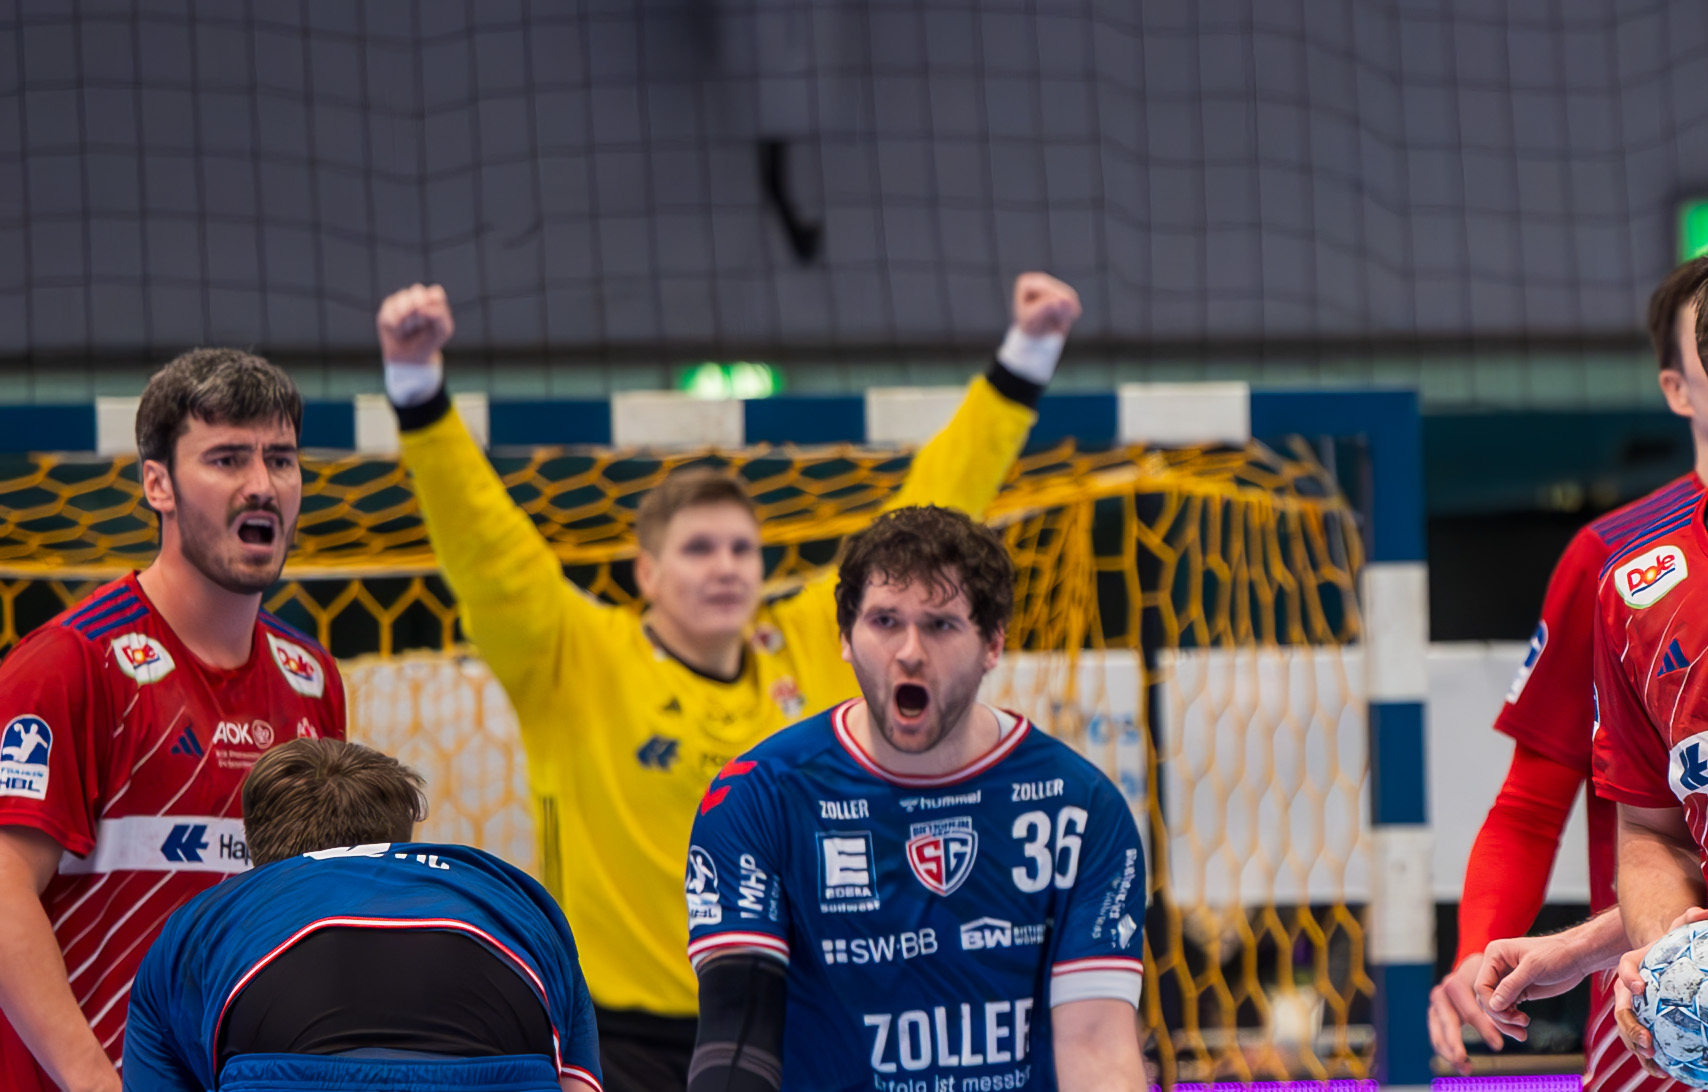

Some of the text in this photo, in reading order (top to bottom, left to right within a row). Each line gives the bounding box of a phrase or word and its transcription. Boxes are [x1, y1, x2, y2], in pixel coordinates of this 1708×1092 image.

[1627, 553, 1676, 592] Dole
[212, 721, 253, 744] AOK
[1012, 778, 1064, 802] ZOLLER
[819, 799, 869, 820] ZOLLER
[1011, 805, 1088, 893] 36
[961, 930, 1012, 950] BW
